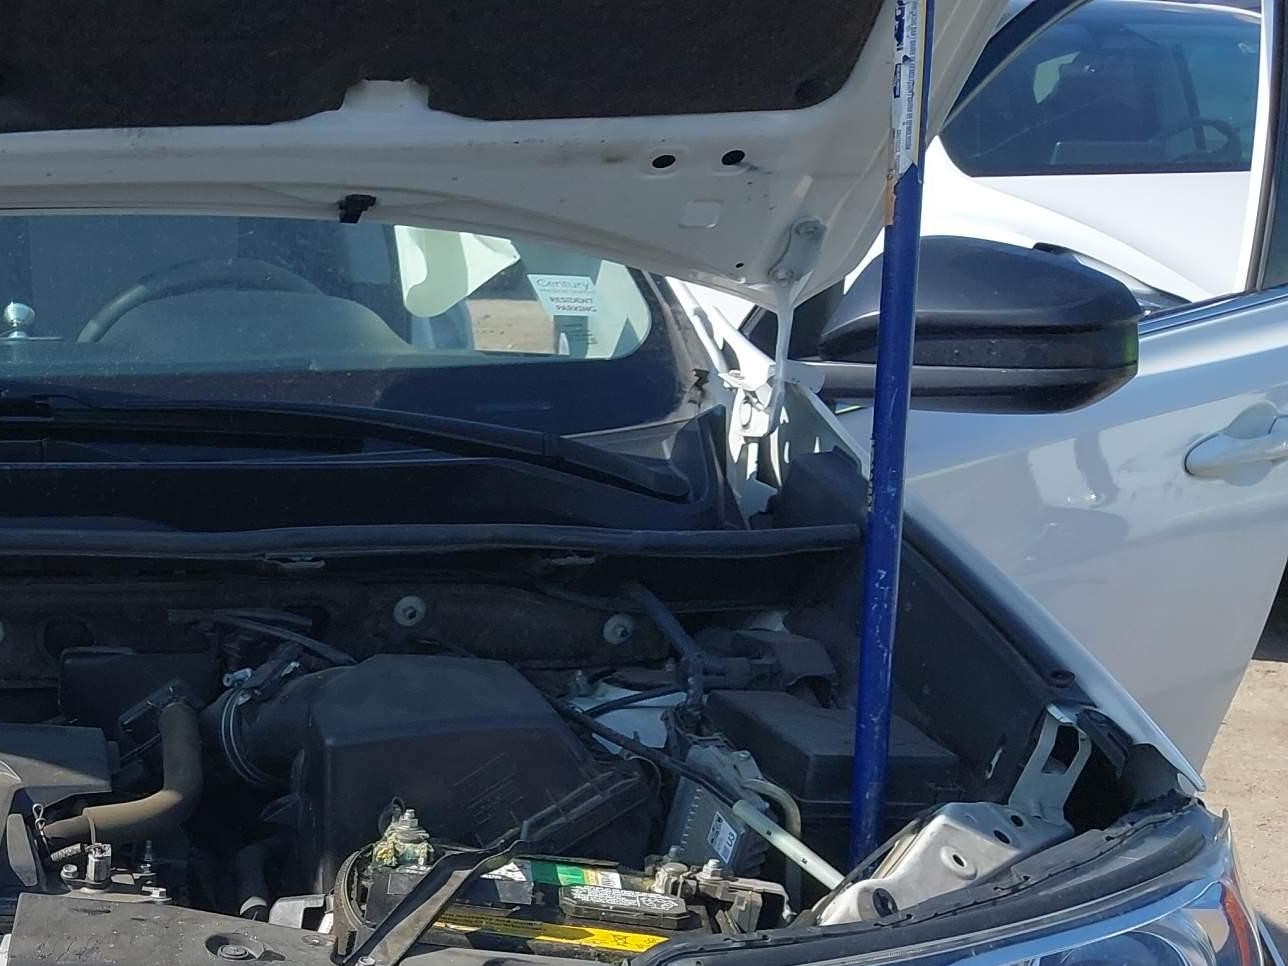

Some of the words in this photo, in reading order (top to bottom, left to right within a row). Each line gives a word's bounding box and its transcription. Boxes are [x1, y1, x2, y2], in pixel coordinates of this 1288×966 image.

[536, 279, 589, 291] Century
[549, 296, 593, 304] RESIDENT
[556, 304, 597, 313] PARKING
[726, 831, 735, 847] U3
